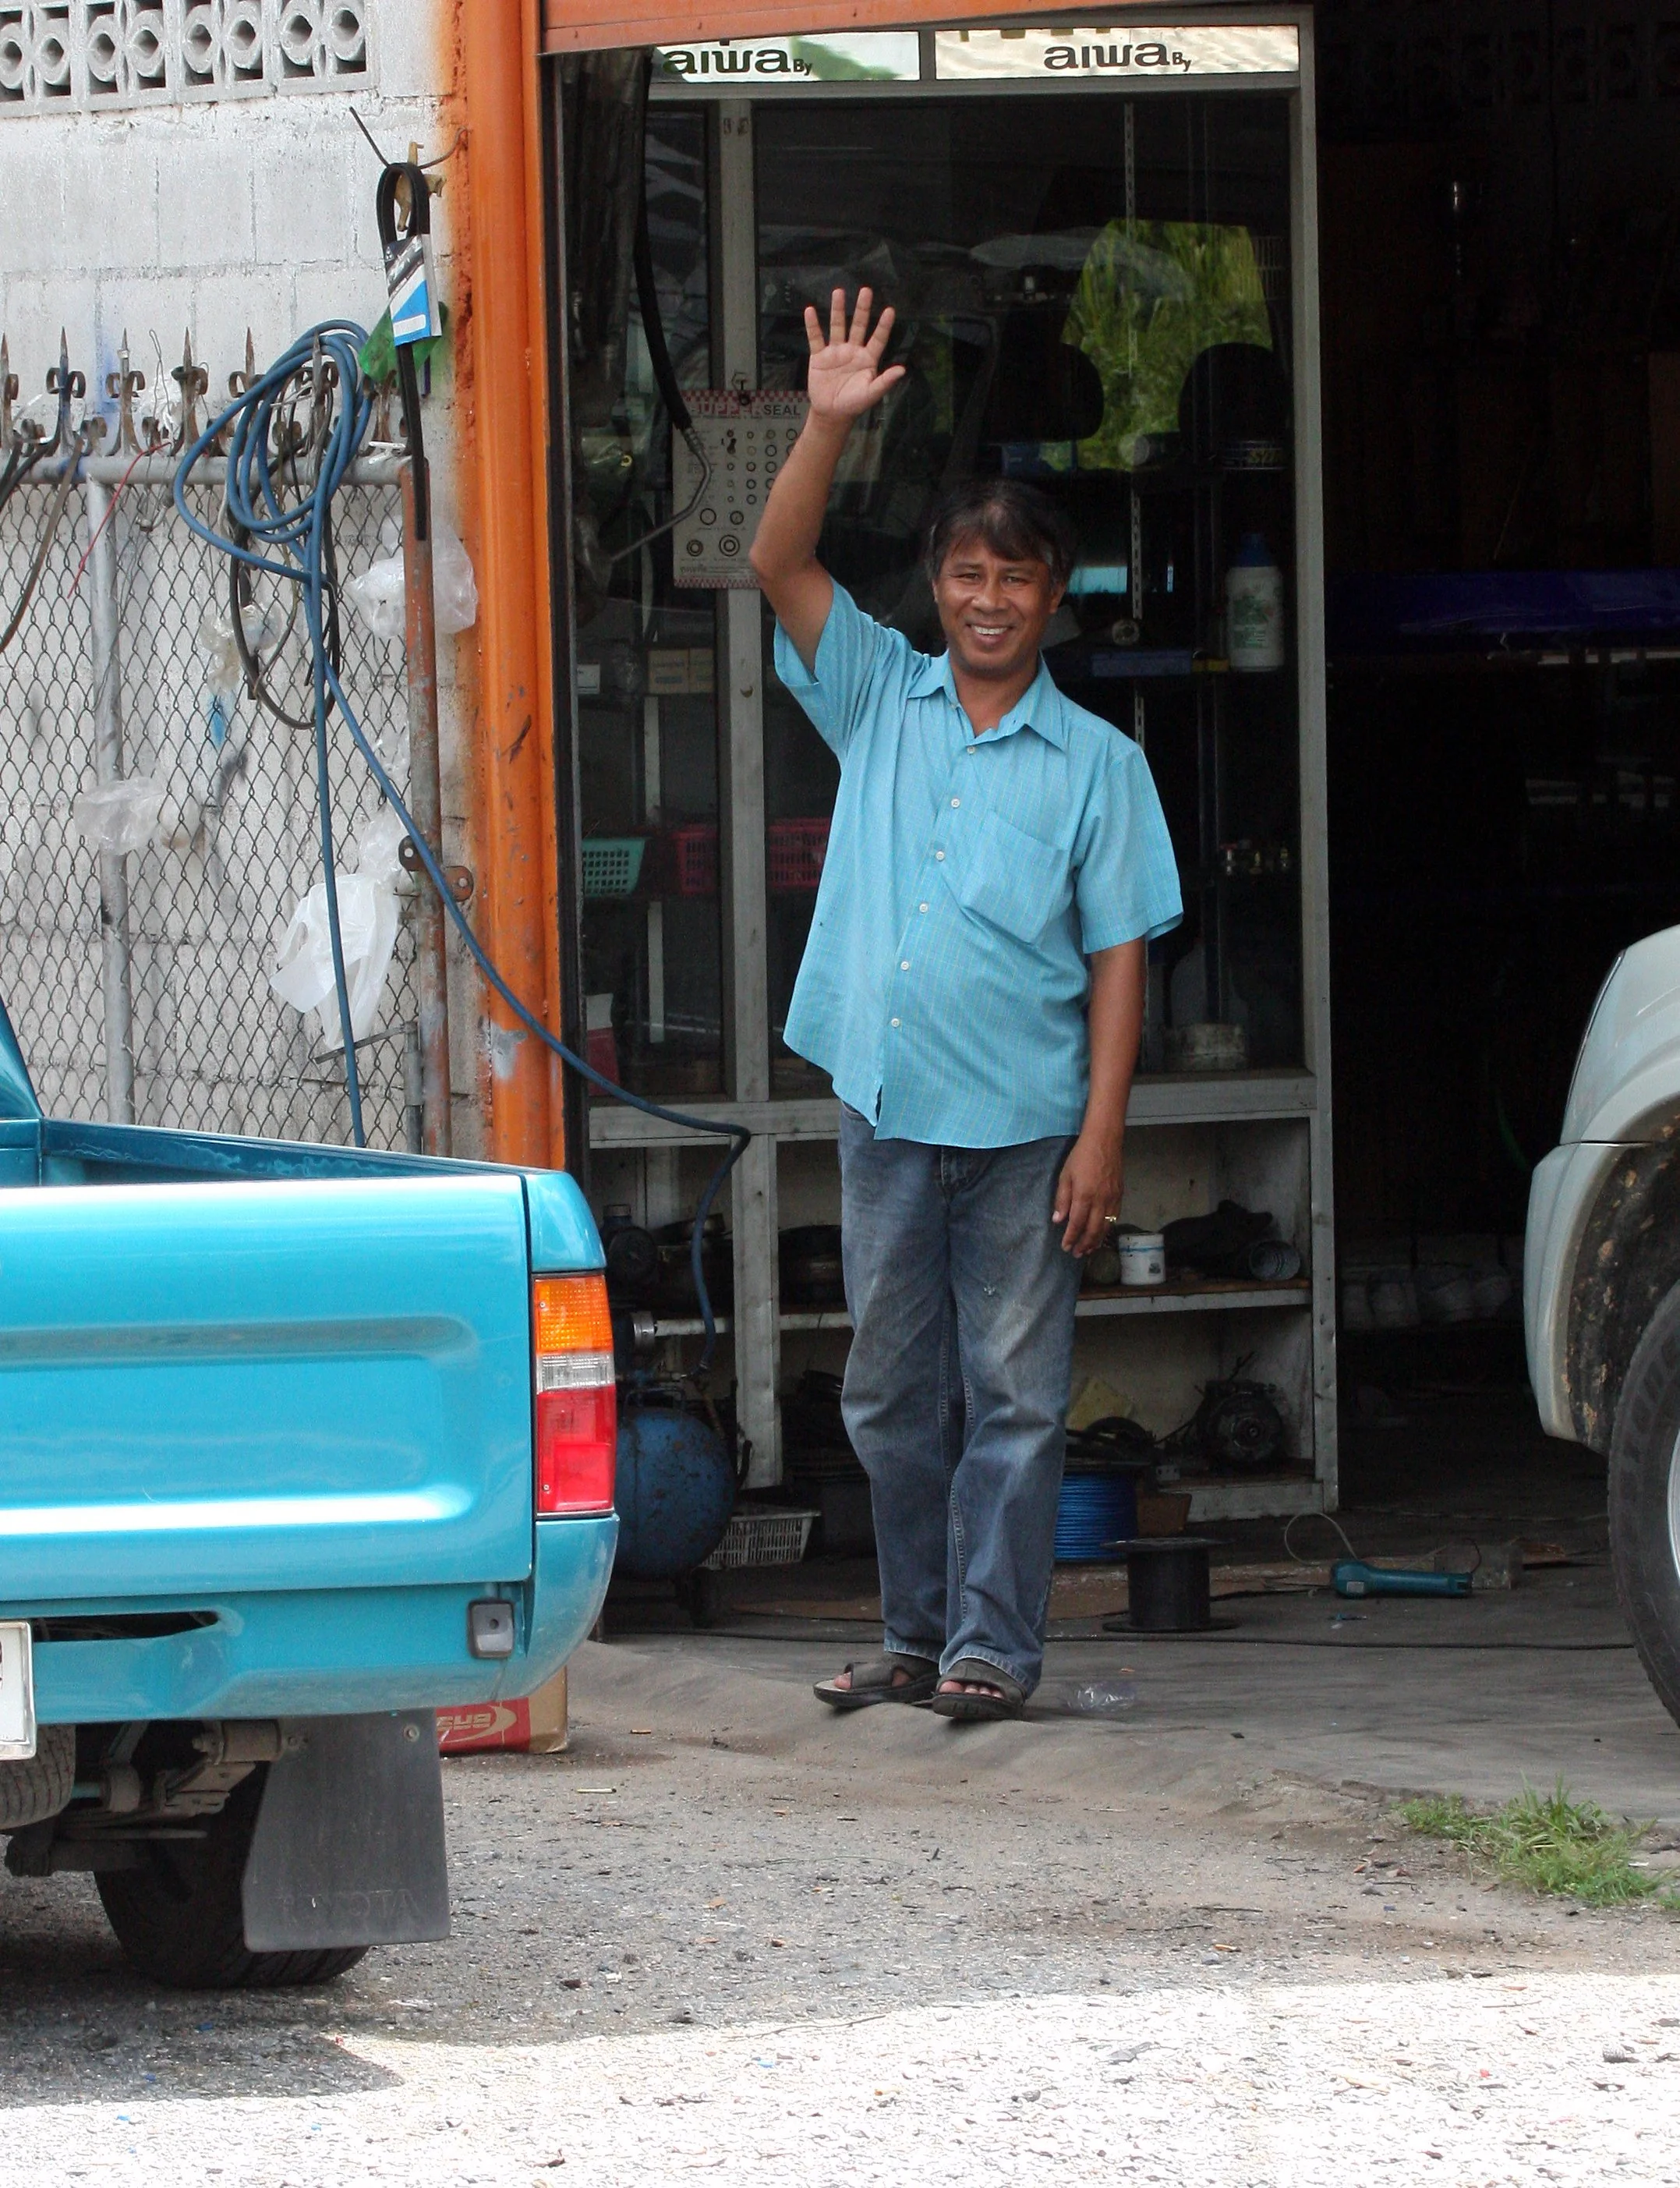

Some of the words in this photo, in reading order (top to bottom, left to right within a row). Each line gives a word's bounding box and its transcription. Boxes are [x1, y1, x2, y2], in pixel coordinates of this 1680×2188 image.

[663, 49, 790, 74] aiwa
[793, 58, 813, 76] By
[1044, 43, 1169, 69] aiwa
[1172, 51, 1191, 72] By
[763, 404, 801, 416] SEAL
